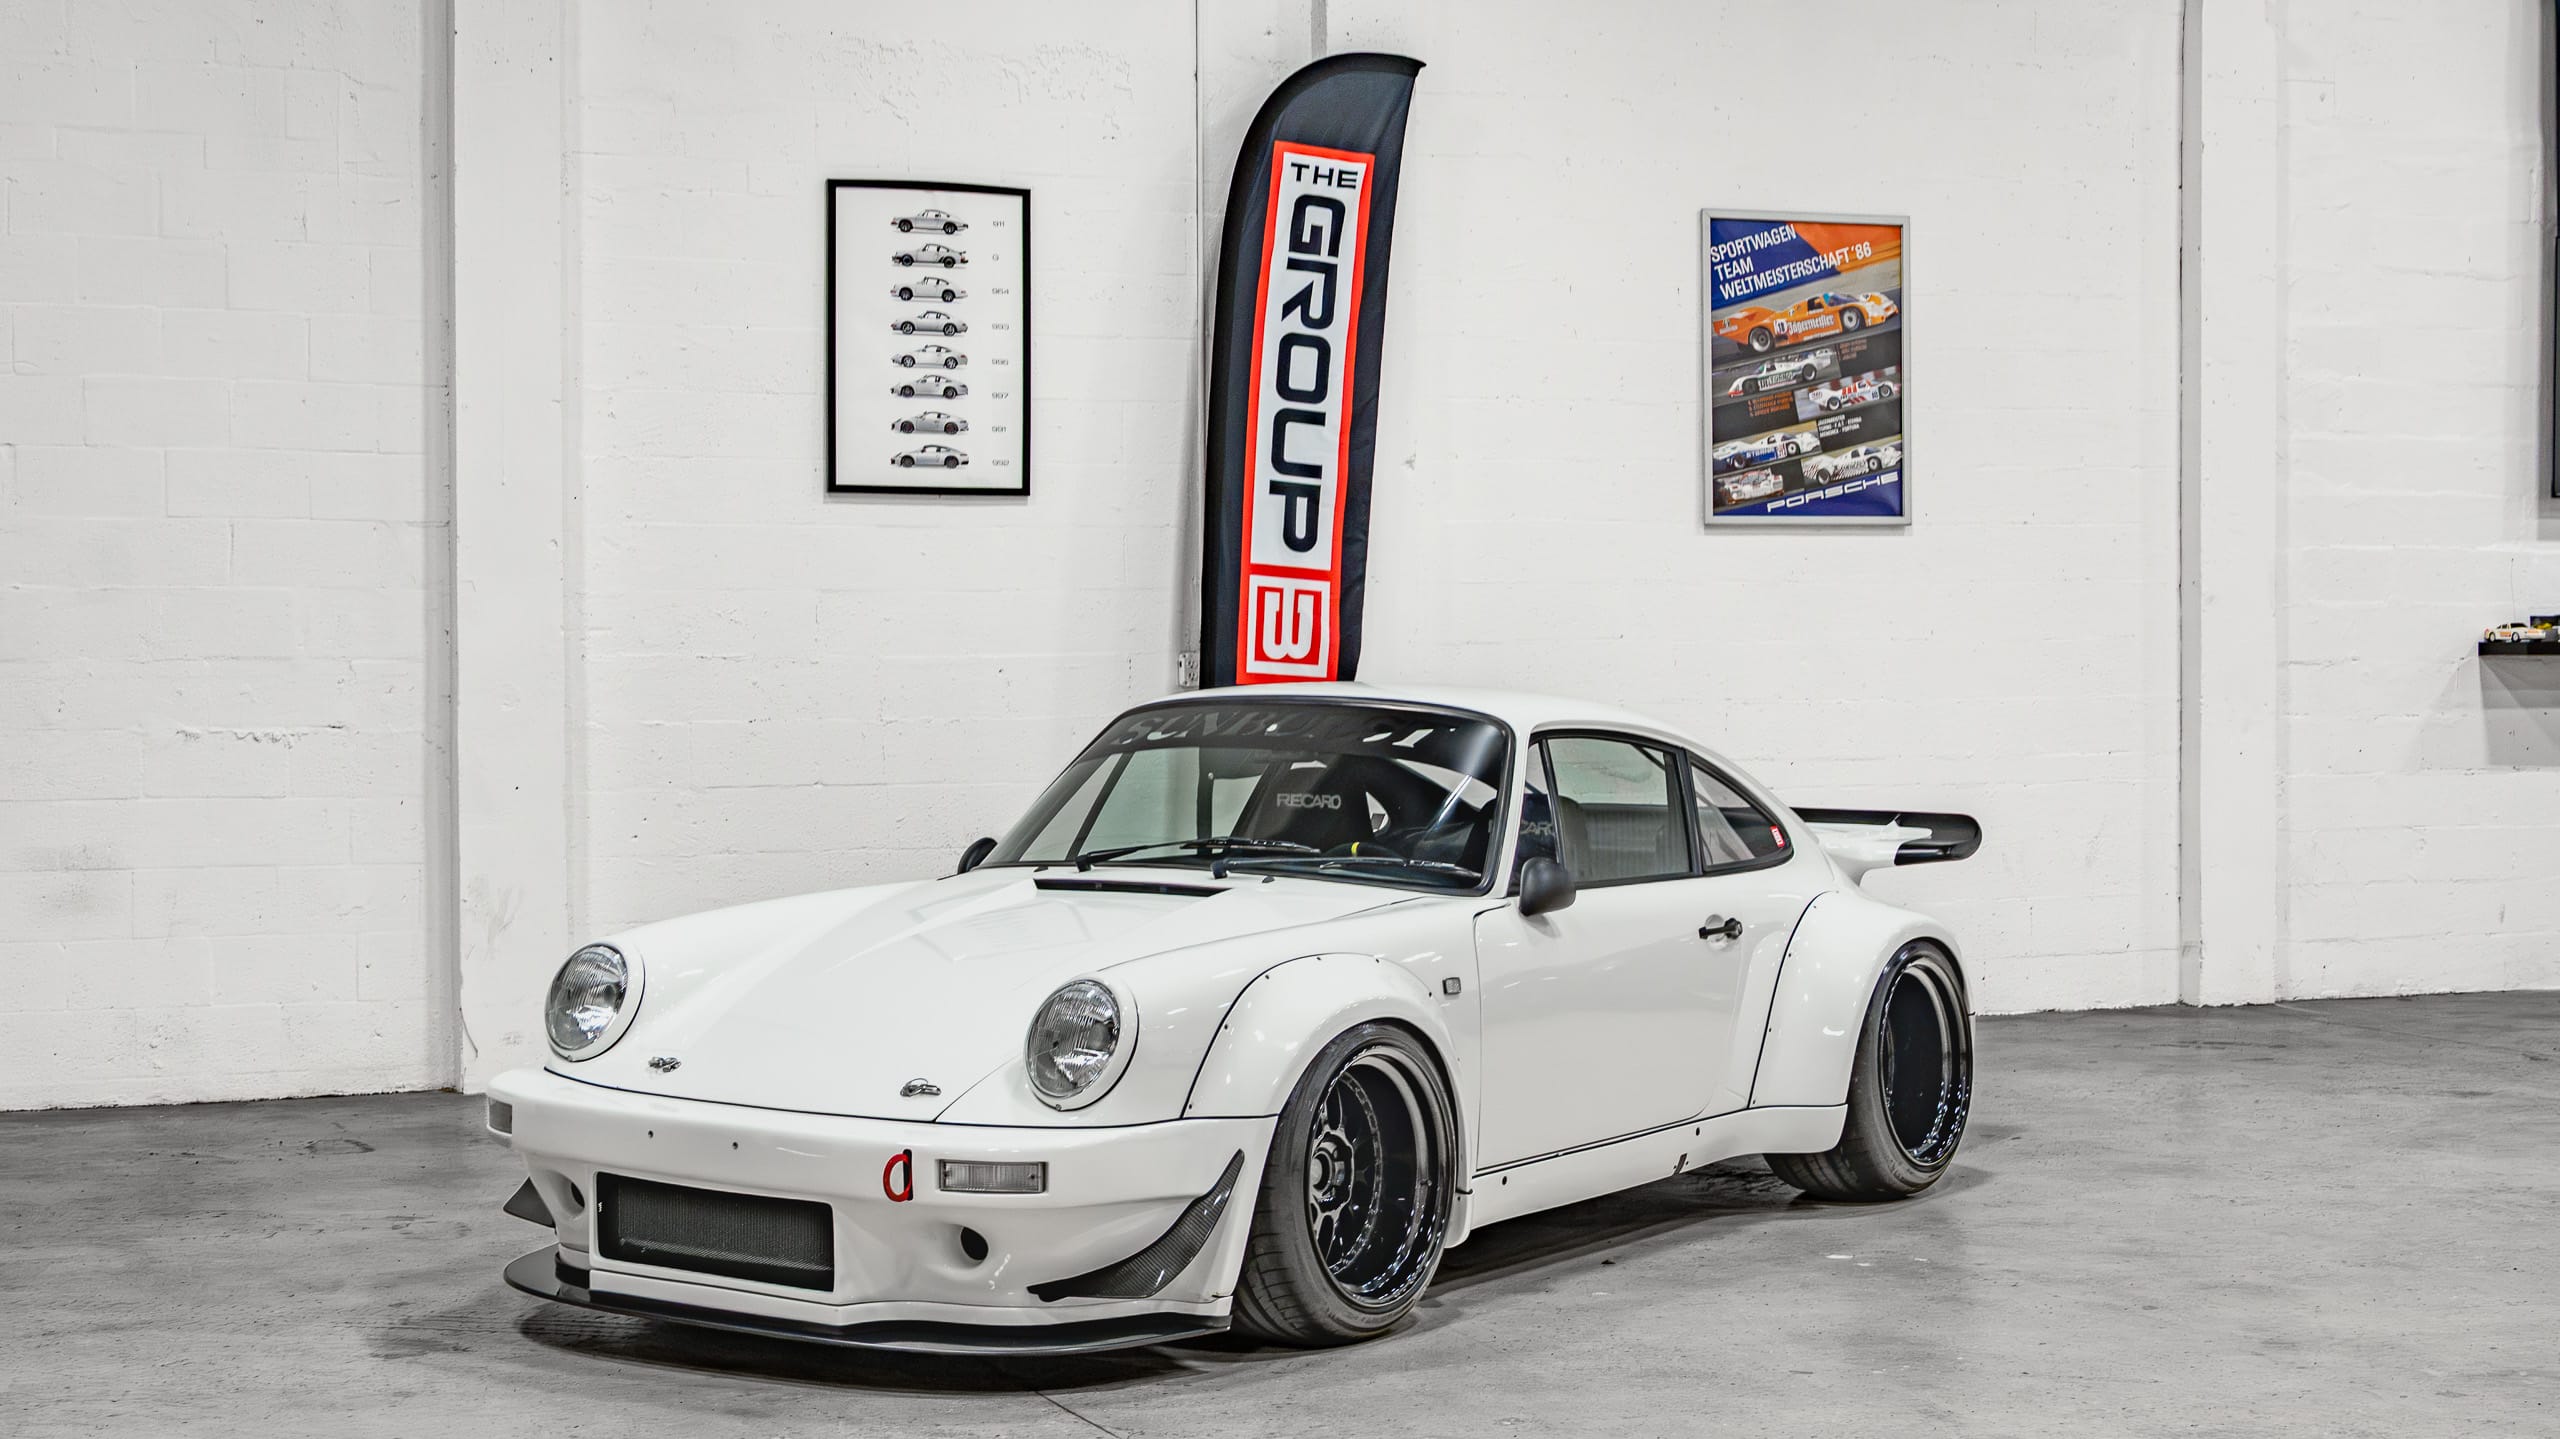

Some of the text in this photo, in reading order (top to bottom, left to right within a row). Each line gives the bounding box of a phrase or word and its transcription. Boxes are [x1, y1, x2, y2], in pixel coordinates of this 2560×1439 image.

[1290, 162, 1360, 190] THE
[1711, 223, 1798, 263] SPORTWAGEN
[1714, 256, 1755, 281] TEAM
[1719, 246, 1850, 300] WELTMEISTERSCHAFT
[1269, 194, 1347, 553] GROUP
[1766, 471, 1899, 513] PORSCHE
[1276, 792, 1342, 809] RECARO
